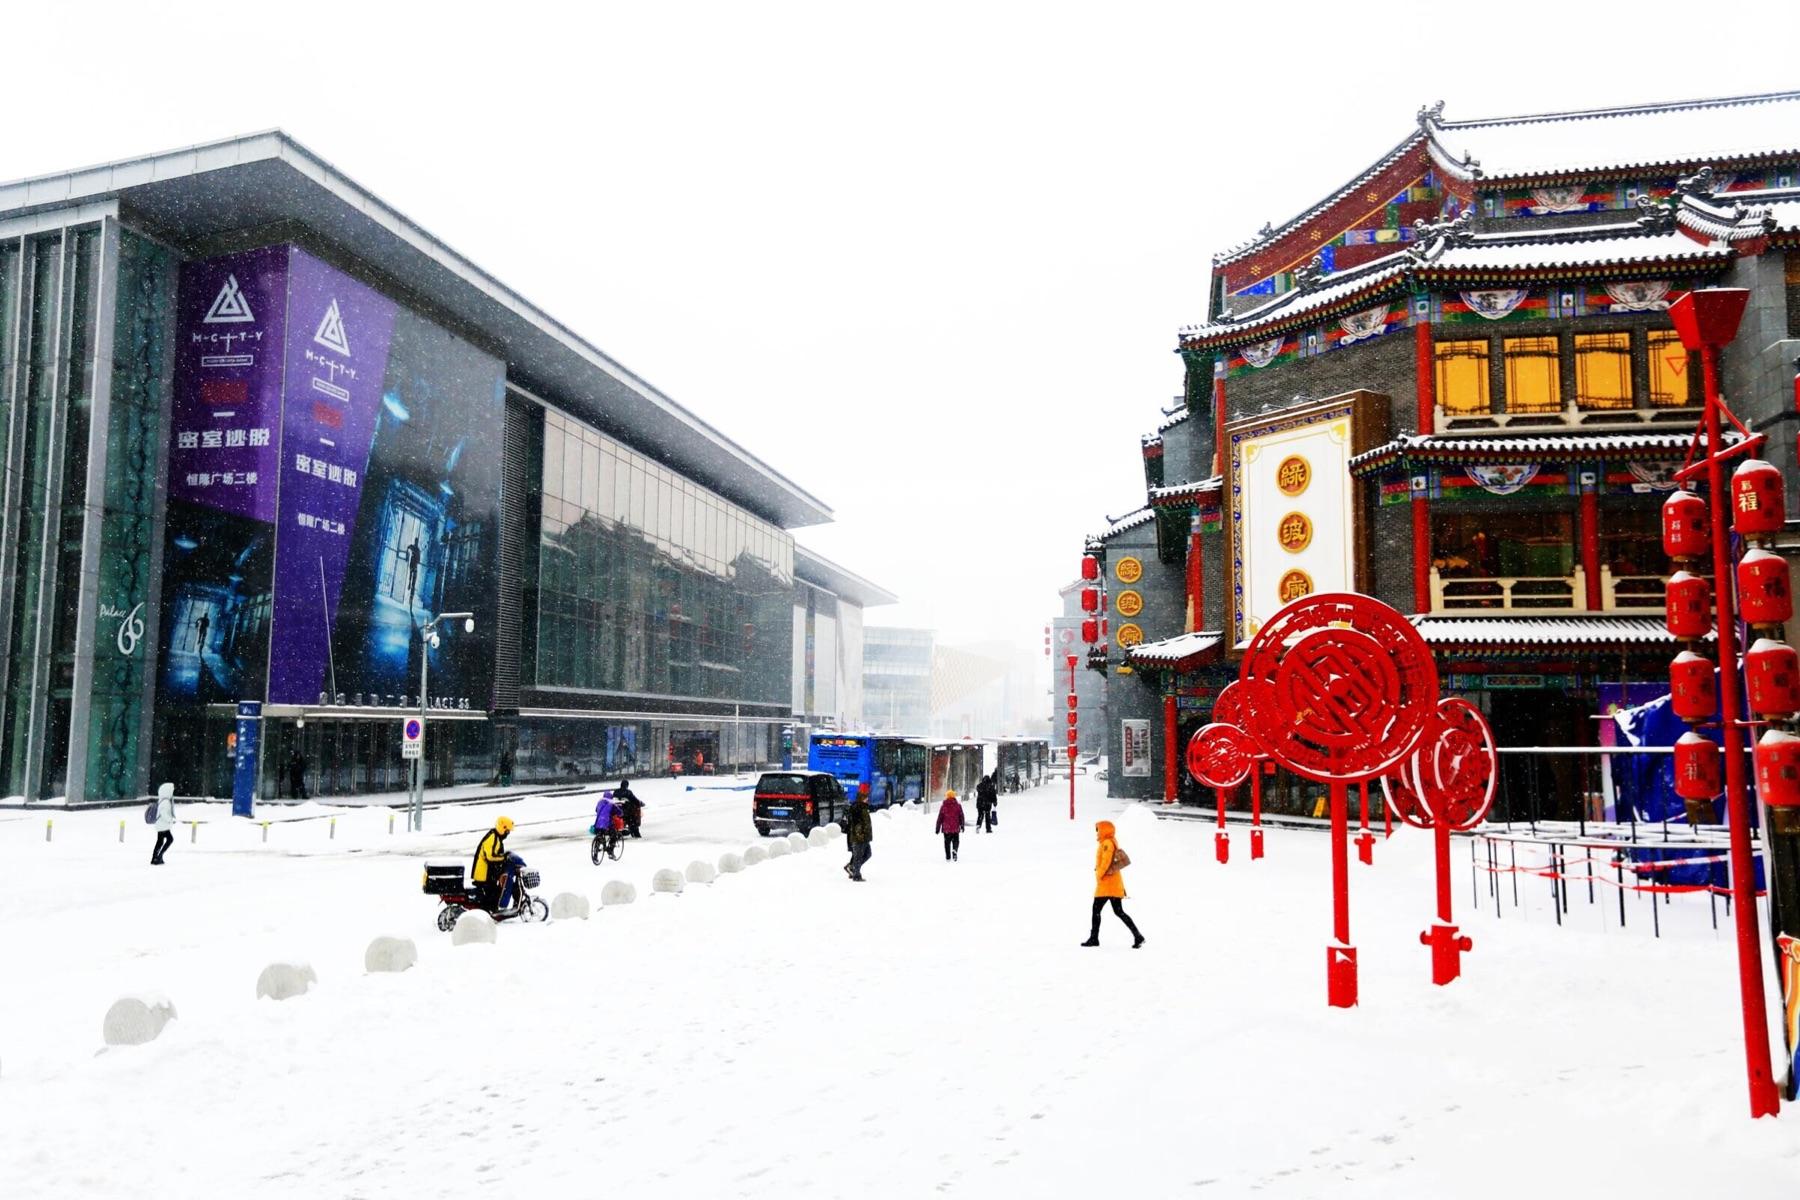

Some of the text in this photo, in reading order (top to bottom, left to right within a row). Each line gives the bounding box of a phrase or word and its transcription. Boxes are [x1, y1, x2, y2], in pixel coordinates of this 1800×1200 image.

[178, 428, 270, 449] 密室逃脱
[1738, 491, 1759, 513] 福
[415, 695, 454, 710] PLACE
